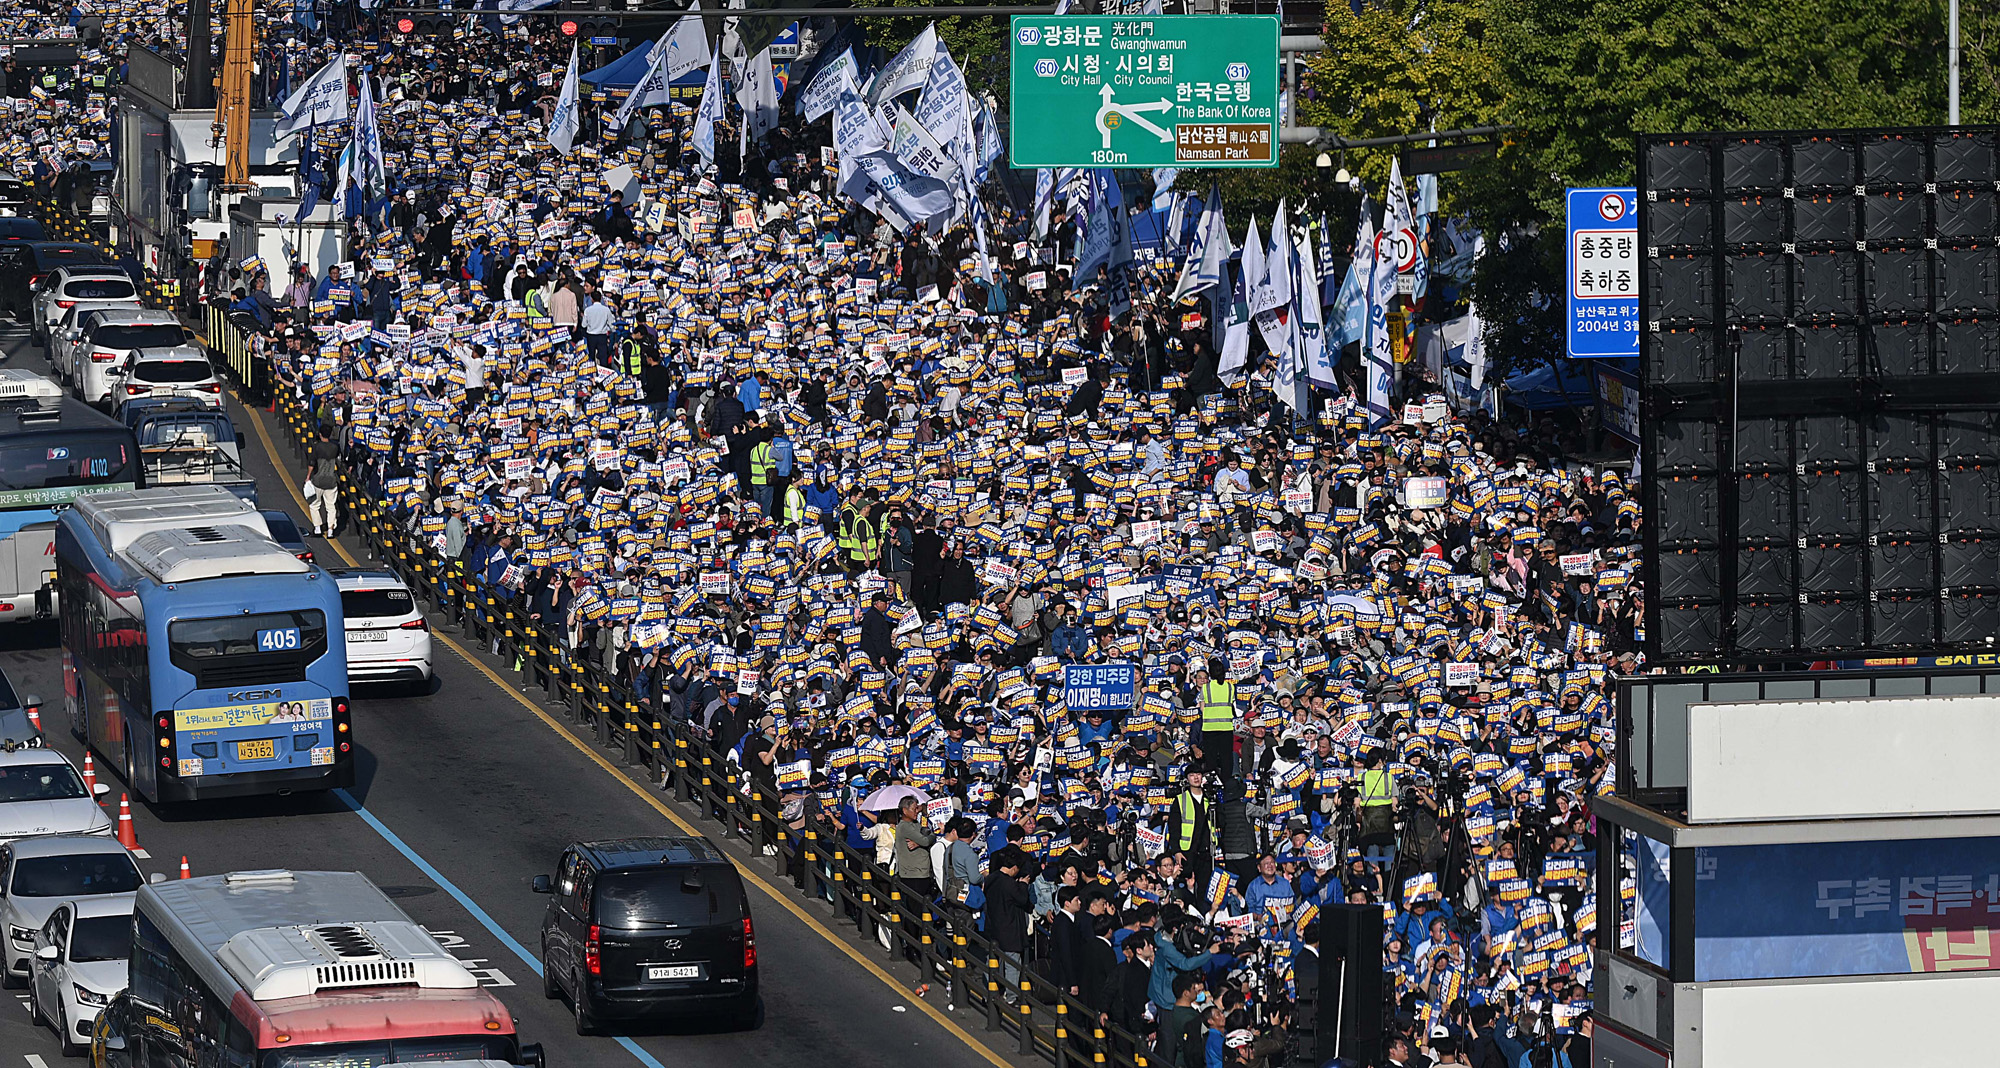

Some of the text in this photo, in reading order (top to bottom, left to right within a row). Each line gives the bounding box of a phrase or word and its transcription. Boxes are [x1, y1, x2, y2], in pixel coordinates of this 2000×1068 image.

[1112, 22, 1154, 36] 光化門
[1022, 30, 1037, 42] 50
[1043, 26, 1103, 46] 광화문
[1110, 38, 1187, 52] Gwanghwamun
[1038, 62, 1054, 74] 60
[1231, 66, 1246, 78] 31
[1060, 74, 1101, 87] City Hall
[1114, 75, 1173, 87] City Council
[1176, 82, 1251, 102] 한국은행
[1176, 106, 1271, 118] The Bank Of Korea
[1178, 127, 1228, 145] 남산공원
[1229, 131, 1269, 144] 南山公園
[1091, 150, 1128, 163] 180m
[1178, 148, 1249, 159] Namsan Park
[1580, 236, 1632, 259] 총중량
[1580, 270, 1631, 292] 축하중
[1576, 306, 1618, 318] 남산육교
[1577, 320, 1619, 332] 2004년
[24, 490, 68, 503] 연말정산도
[702, 581, 728, 589] 진상규명!
[262, 630, 296, 649] 405
[1070, 668, 1130, 685] 강한 민주당
[1402, 667, 1424, 681] 김건희를
[1406, 672, 1429, 687] 특검하라!
[228, 688, 281, 702] KGM
[1067, 688, 1132, 708] 이재명이 합니다
[845, 696, 870, 710] 김건희를
[1145, 696, 1174, 709] 김건희를
[1143, 702, 1172, 717] 특검하라!
[1127, 715, 1154, 725] 김건희를
[1555, 714, 1581, 724] 김건희를
[292, 722, 323, 732] 삼성여객
[1554, 721, 1584, 732] 특검하라!
[1511, 737, 1537, 746] 김건희를
[973, 747, 1000, 756] 김건희를
[1509, 743, 1537, 754] 특검하라!
[1067, 749, 1092, 761] 김건희를
[1475, 754, 1500, 763] 김건희를
[1068, 757, 1094, 769] 특검하라!
[1475, 761, 1503, 771] 특검하라!
[1496, 766, 1519, 785] 김건희를
[1500, 771, 1525, 793] 특검하라!
[1465, 793, 1491, 806] 특검하라!
[1545, 860, 1576, 870] 김건희를
[1545, 868, 1578, 880] 특검하라!
[1499, 880, 1528, 891] 김건희를
[1500, 888, 1532, 901] 특검하라!
[673, 968, 693, 976] 5421
